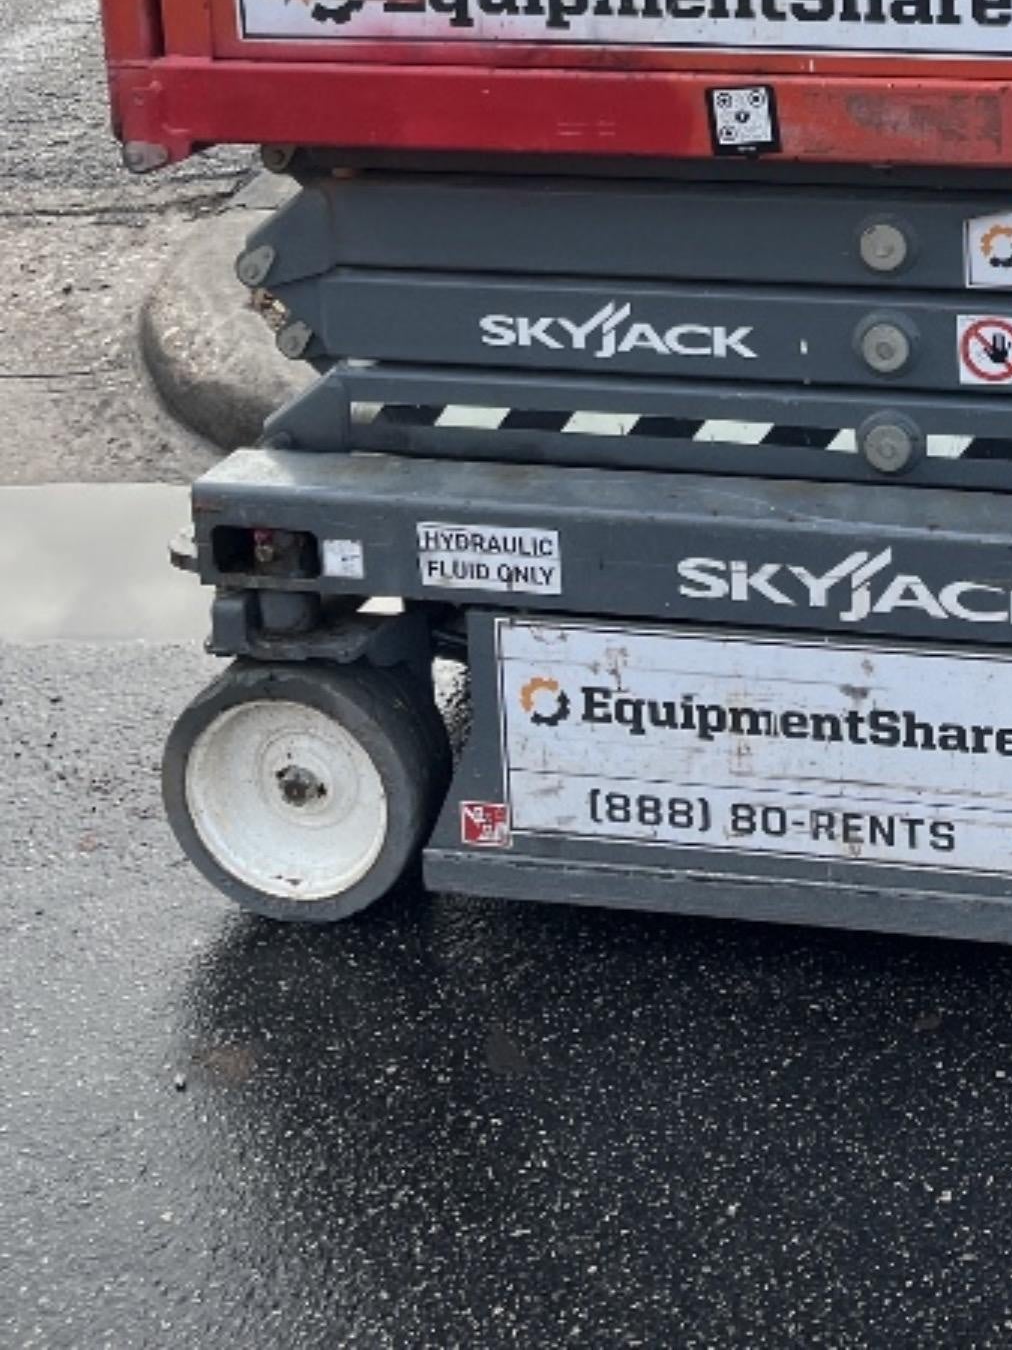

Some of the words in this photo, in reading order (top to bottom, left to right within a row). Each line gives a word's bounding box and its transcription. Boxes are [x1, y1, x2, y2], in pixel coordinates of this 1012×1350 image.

[479, 299, 758, 358] SKYJACK
[422, 530, 553, 558] HYDRAULIC
[426, 560, 489, 581] FLUID
[497, 563, 554, 587] ONLY
[589, 788, 712, 831] (888)
[730, 803, 957, 850] 80-RENTS
